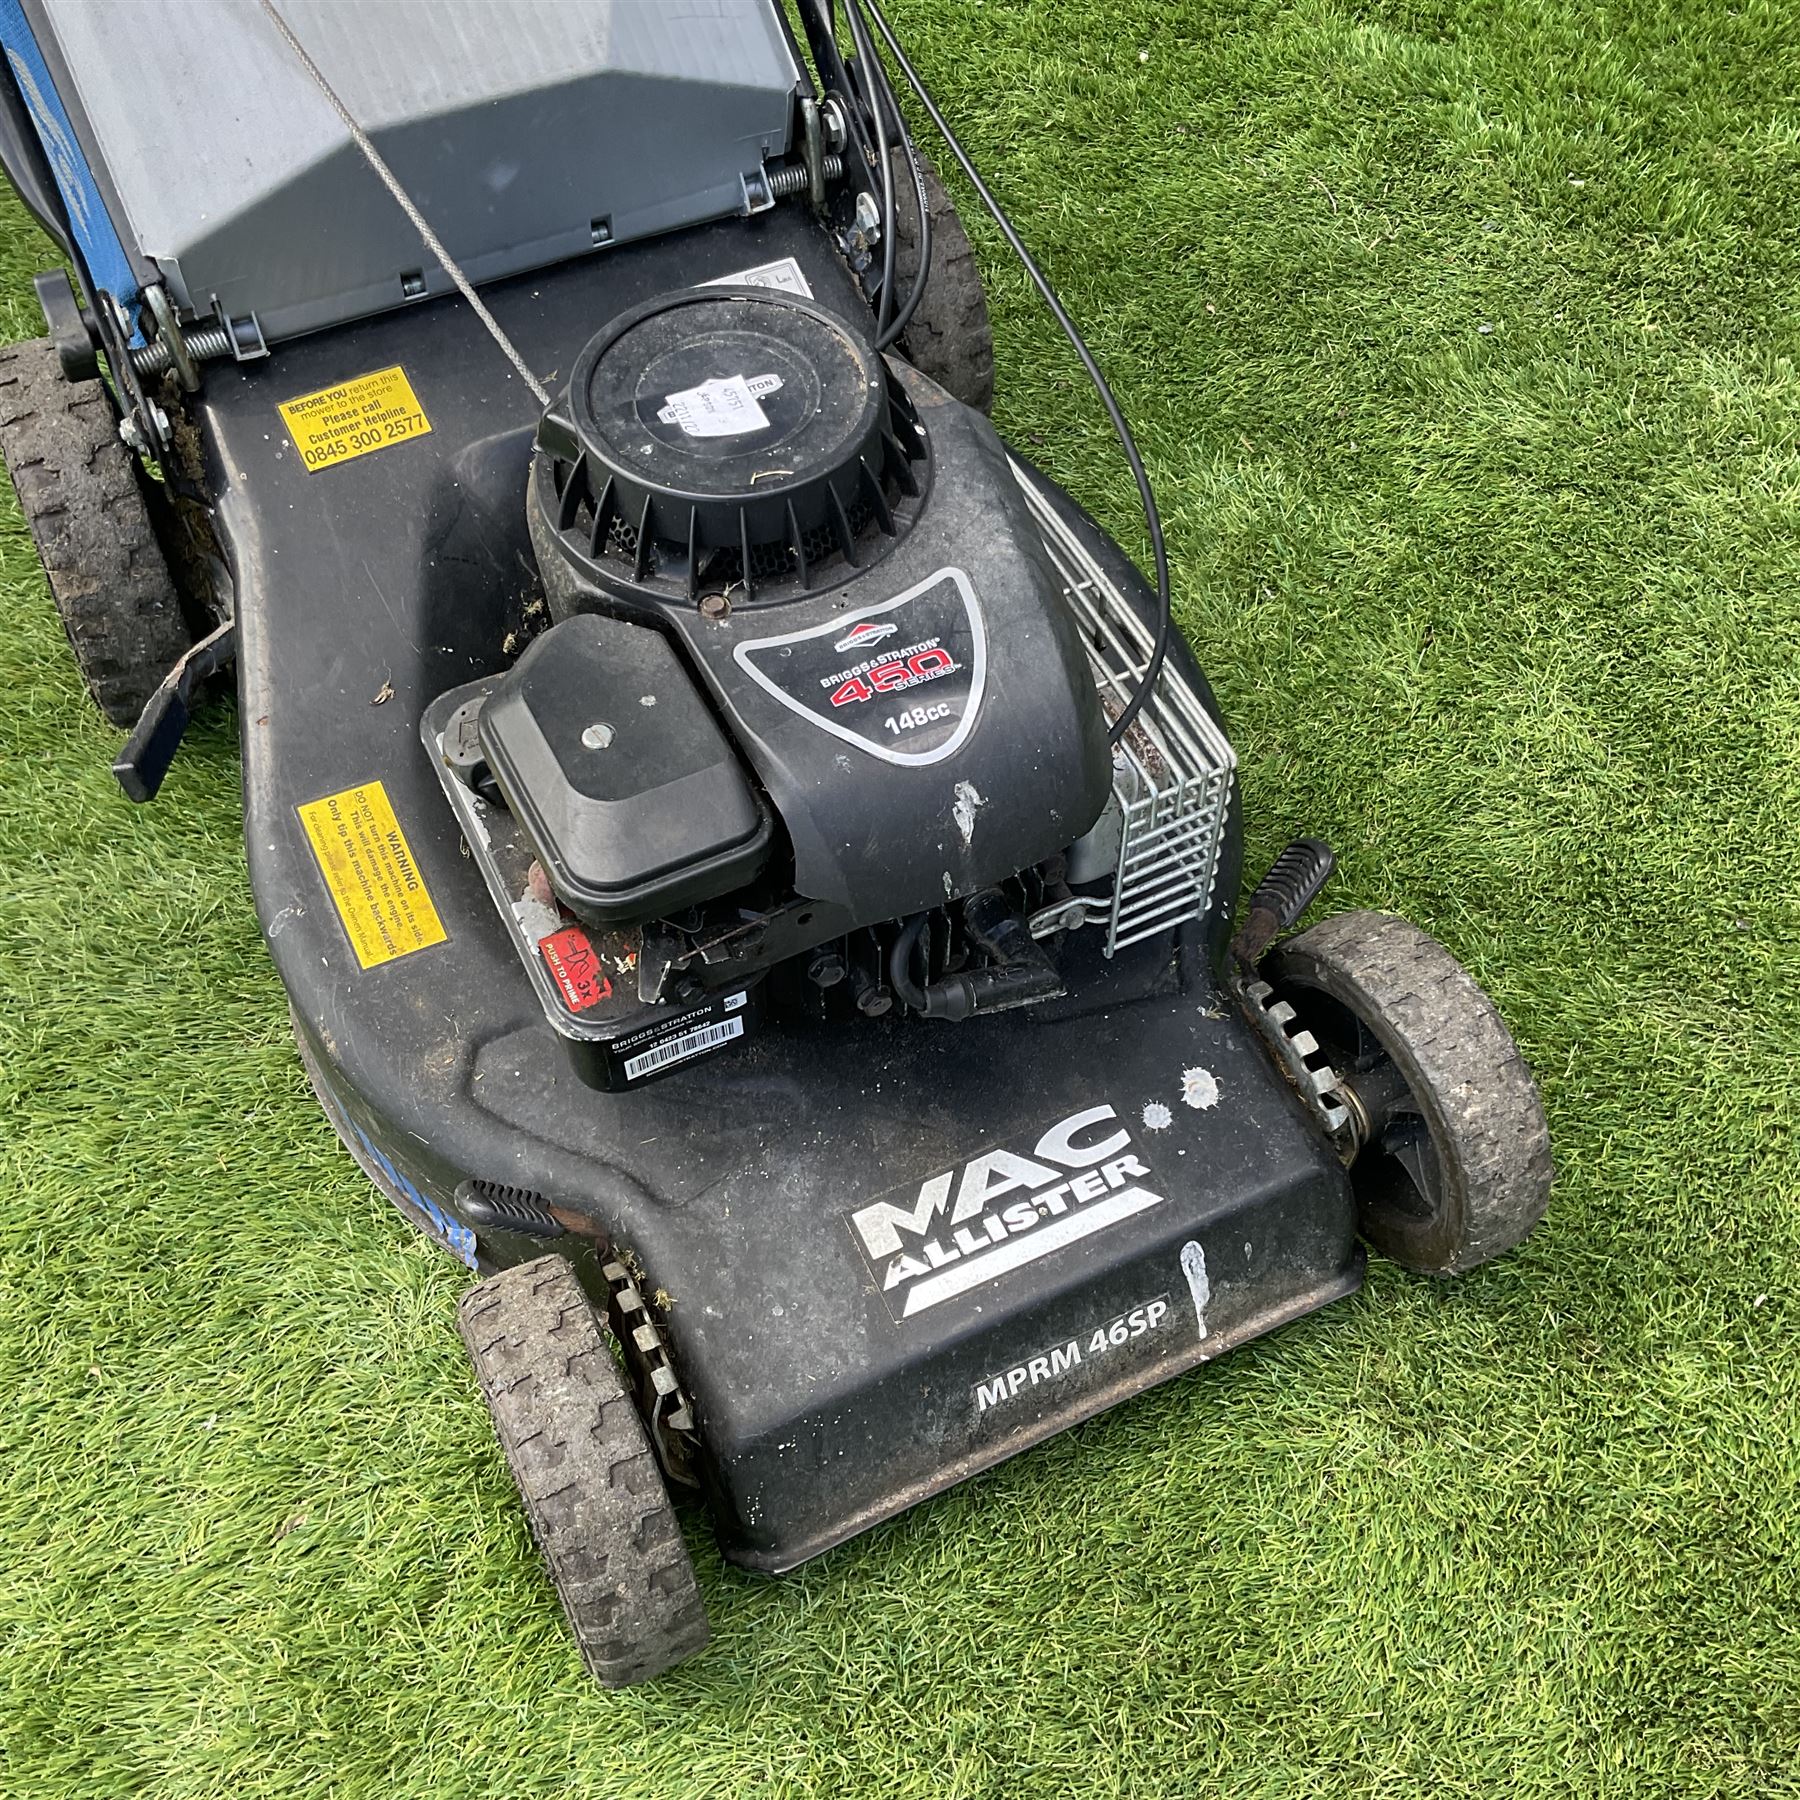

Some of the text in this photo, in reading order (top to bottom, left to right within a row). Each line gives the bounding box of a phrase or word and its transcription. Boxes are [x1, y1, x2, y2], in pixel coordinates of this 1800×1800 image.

[289, 373, 399, 414] BEFORE YOU return this
[301, 385, 392, 420] mower to the store
[322, 400, 382, 426] Please call
[305, 414, 423, 465] 0845 300 2577
[309, 405, 406, 445] Customer Helpline
[830, 648, 953, 708] 450
[893, 665, 955, 691] SERIES
[884, 703, 950, 735] 148cc
[308, 811, 318, 822] For
[310, 822, 330, 851] cleaning
[350, 811, 362, 830] This
[359, 831, 371, 848] will
[366, 848, 383, 882] damage
[380, 883, 390, 897] the
[355, 791, 423, 946] DO NOT turn this machine on its side.
[385, 830, 419, 892] WARNING
[327, 800, 397, 956] Only tip this machine backwards
[332, 871, 344, 887] refer
[342, 895, 352, 907] the
[546, 944, 580, 1004] PUSH TO PRIME
[577, 981, 592, 999] 3x
[852, 1104, 1132, 1260] MAC
[883, 1154, 1152, 1292] ALLISTER
[975, 1300, 1167, 1412] MPRM 46SP
